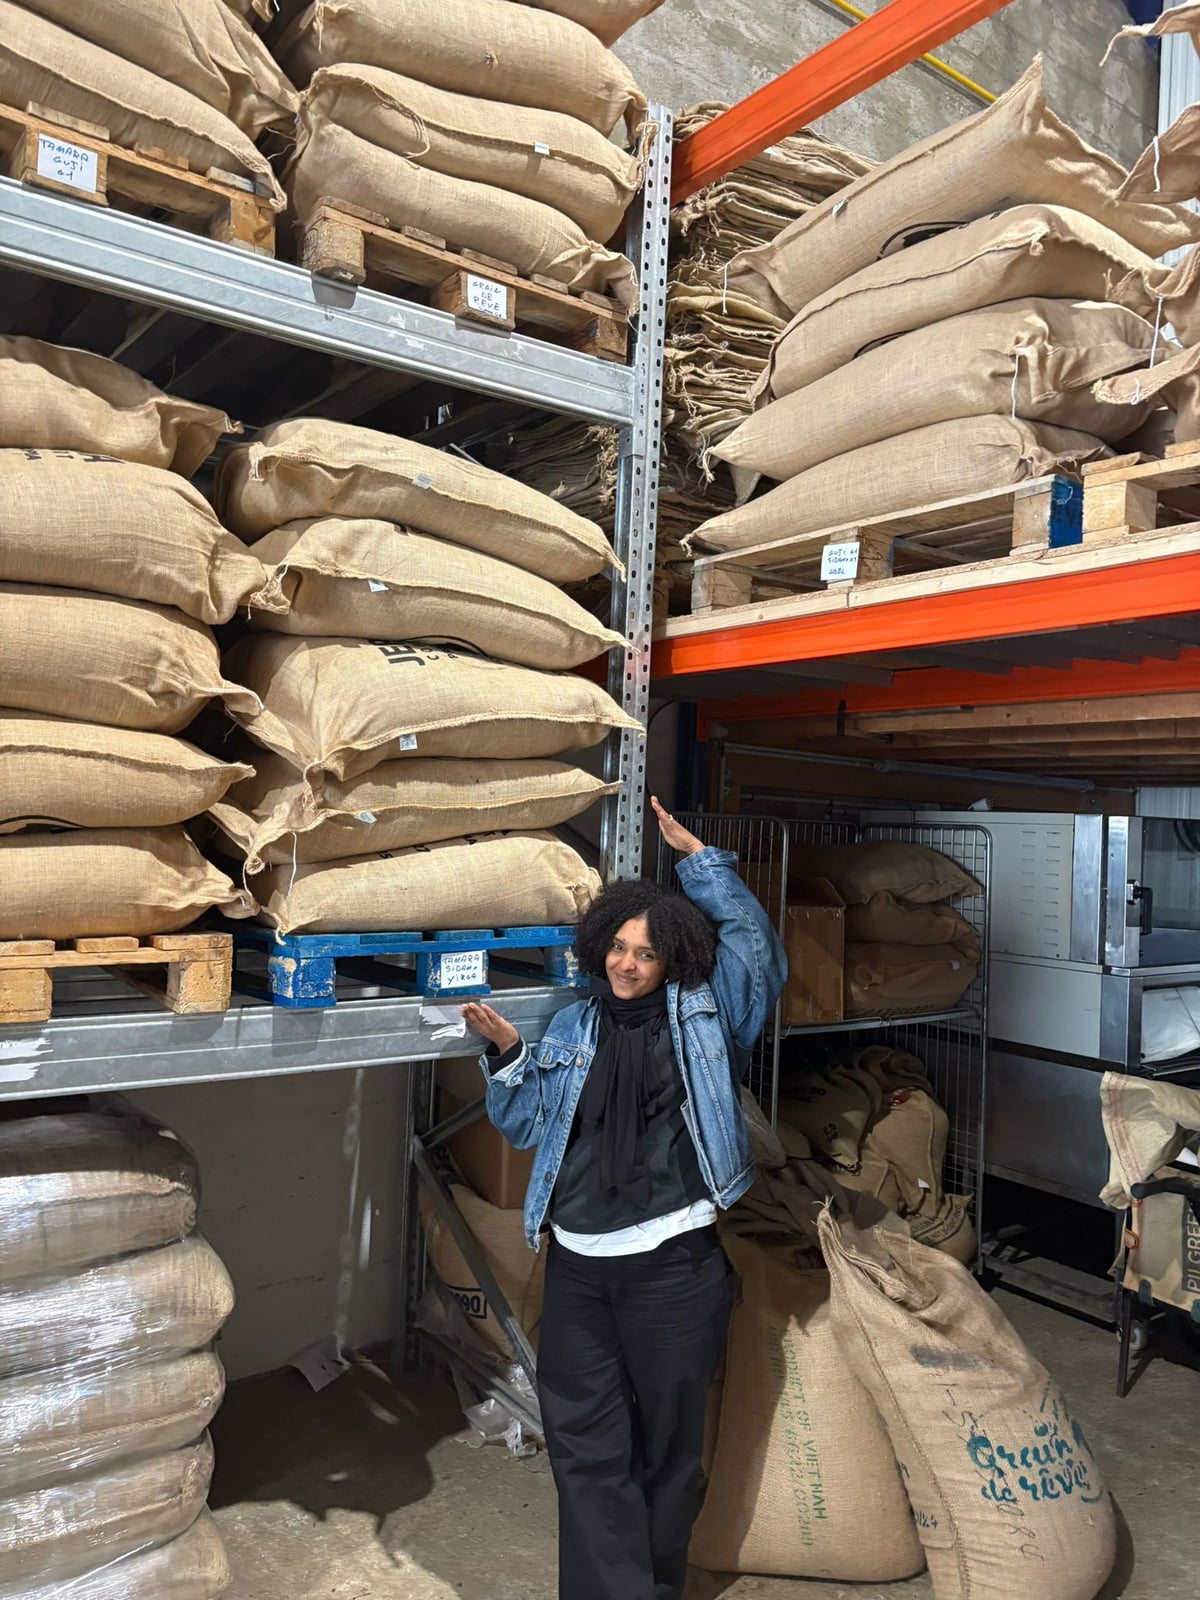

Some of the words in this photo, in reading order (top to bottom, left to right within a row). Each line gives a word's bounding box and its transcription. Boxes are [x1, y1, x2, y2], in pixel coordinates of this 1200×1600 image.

[39, 138, 89, 162] TAMARA
[481, 292, 493, 301] DE
[442, 954, 480, 964] TAMARA
[796, 1408, 812, 1432] OF
